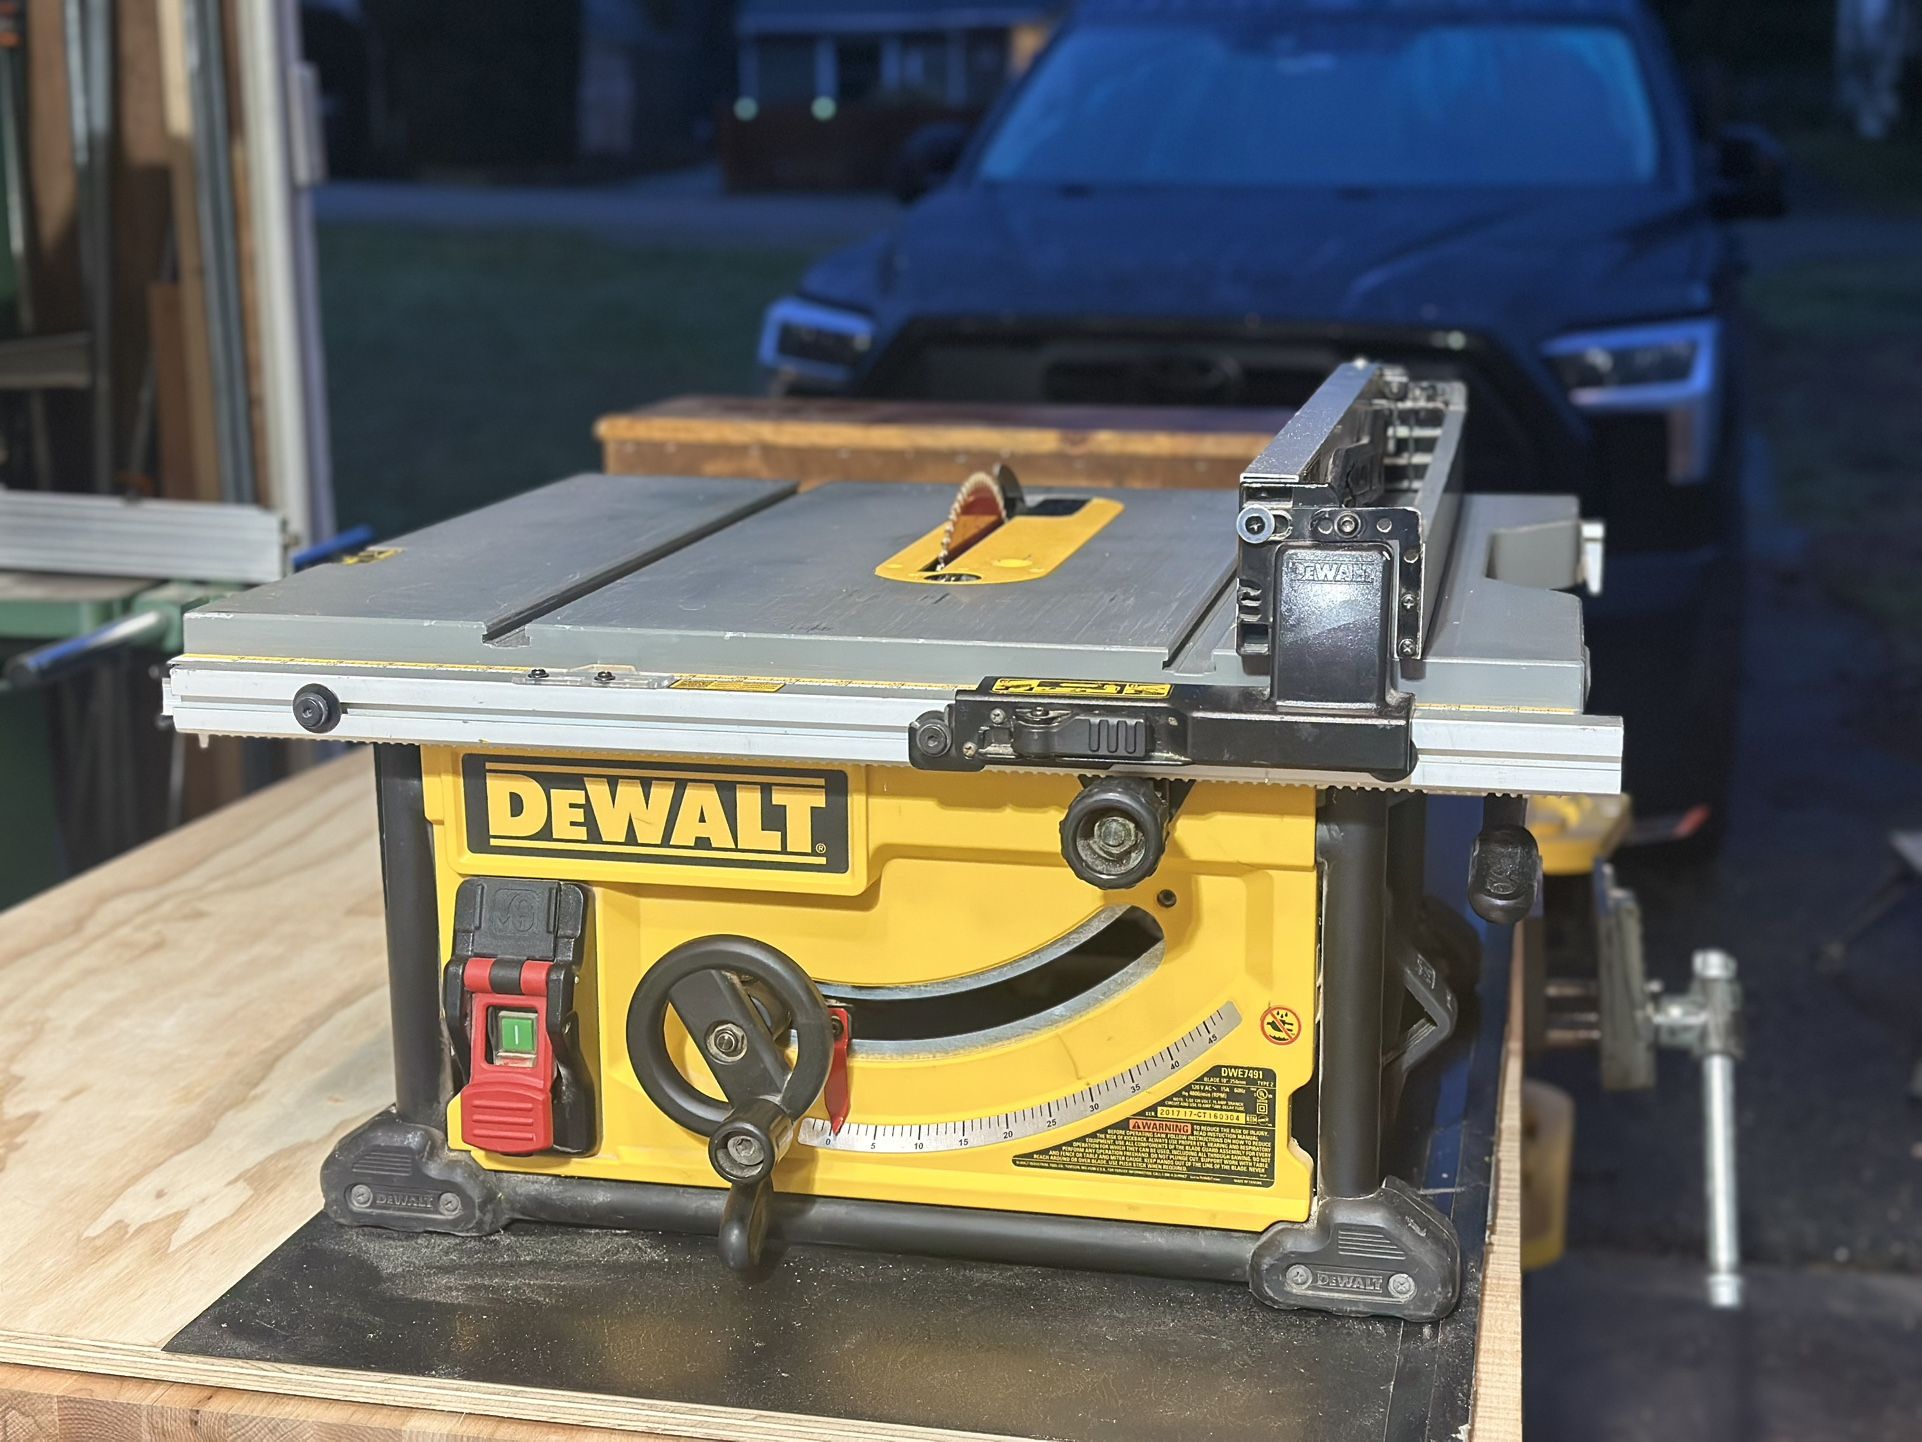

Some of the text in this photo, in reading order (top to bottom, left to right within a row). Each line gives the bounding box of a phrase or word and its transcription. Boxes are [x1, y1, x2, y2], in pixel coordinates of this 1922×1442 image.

[486, 771, 826, 854] DEWALT
[1221, 1067, 1263, 1079] DWE7491
[826, 1034, 1218, 1150] 0 5 10 15 20 25 30 35 40 45
[1160, 1108, 1179, 1116] 2017
[1141, 1121, 1188, 1133] WARNING
[1318, 1274, 1382, 1290] DEWALT
